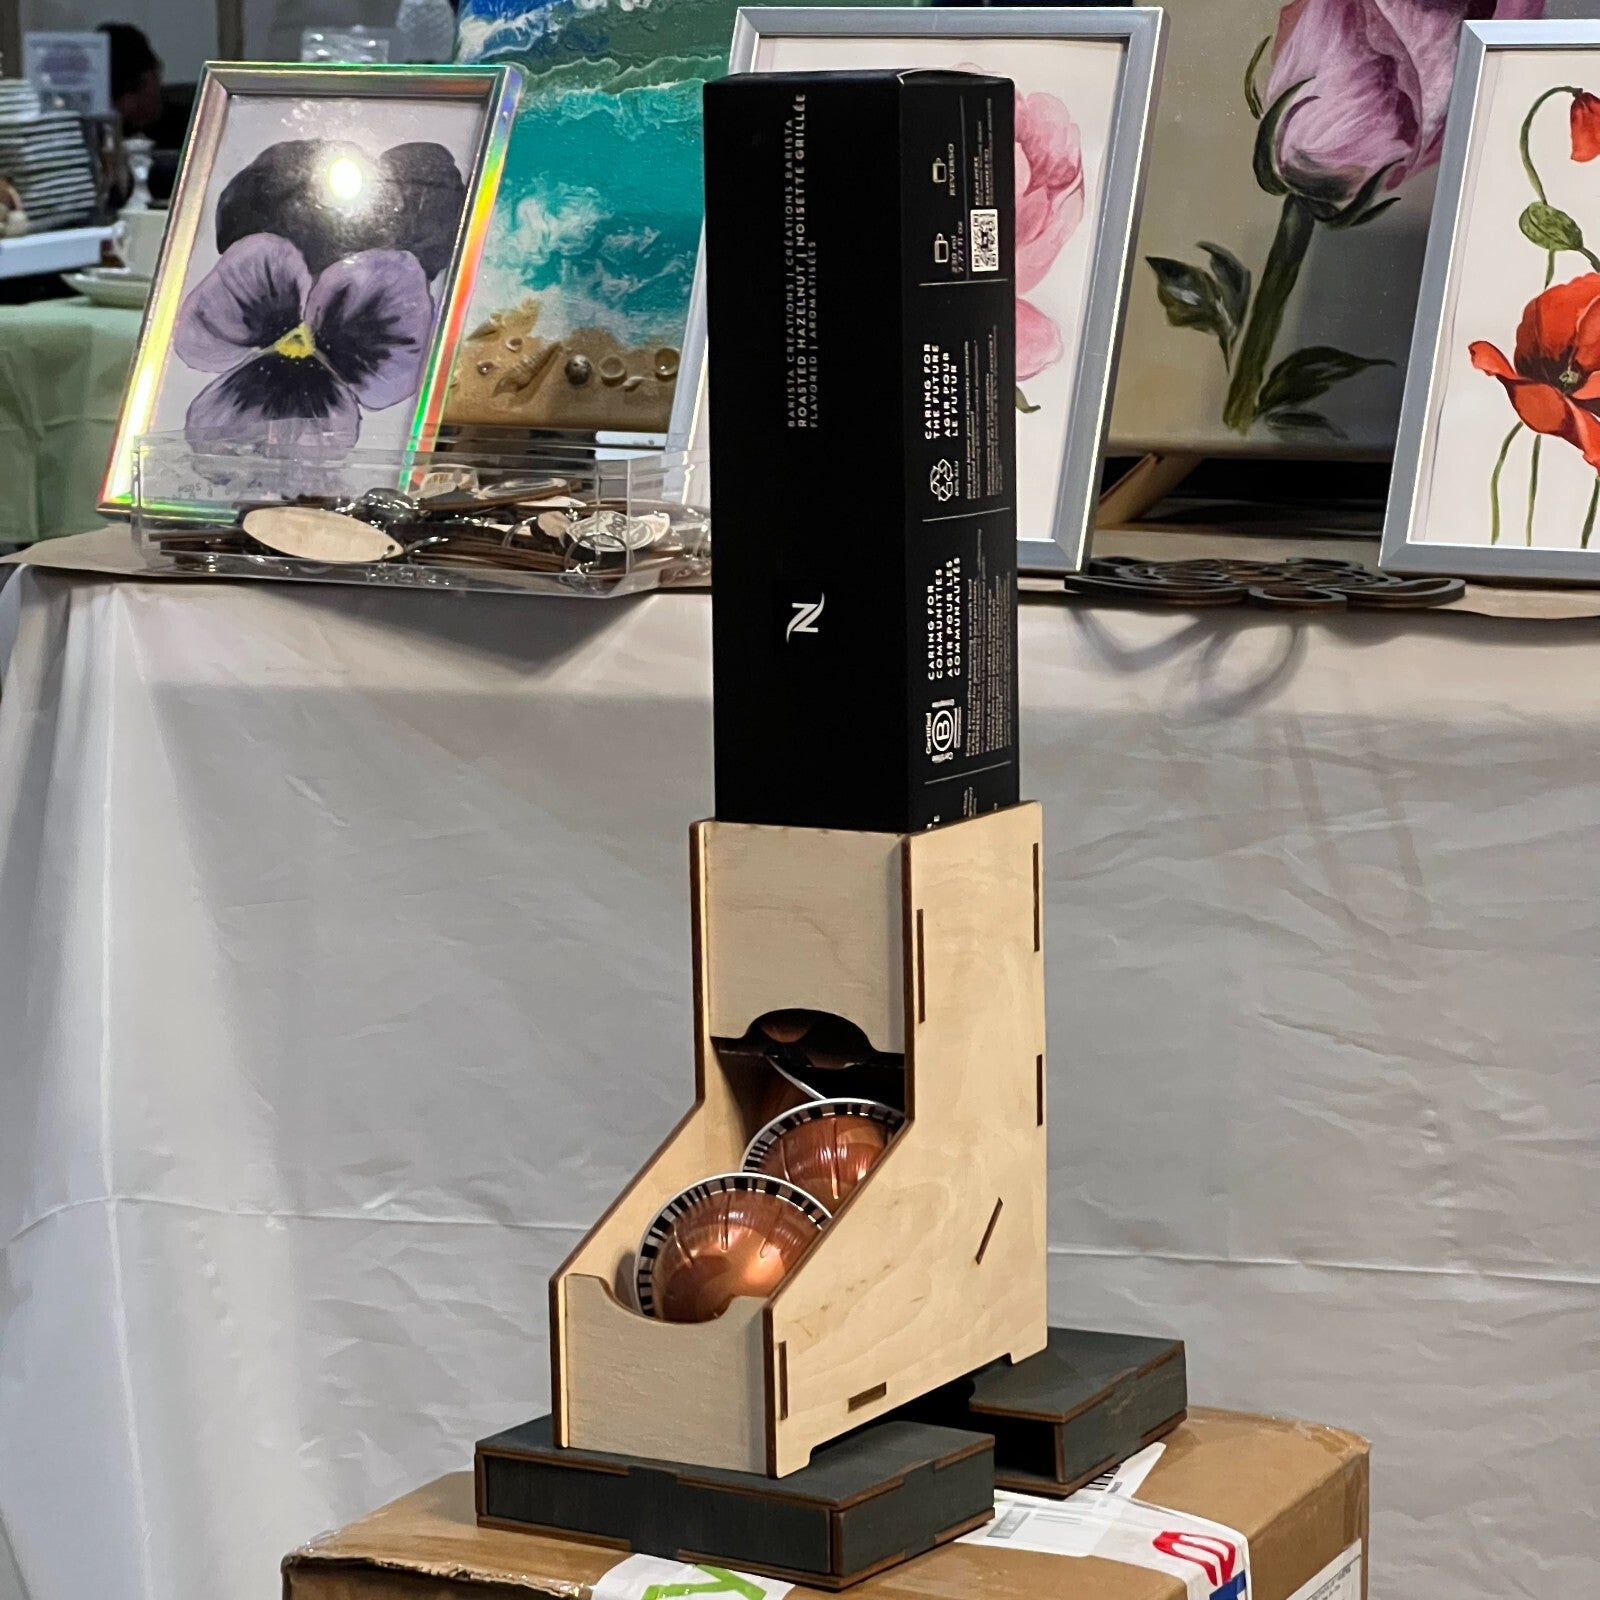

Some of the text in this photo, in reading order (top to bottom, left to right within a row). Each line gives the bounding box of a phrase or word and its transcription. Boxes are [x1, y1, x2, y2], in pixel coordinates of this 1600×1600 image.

[784, 119, 793, 179] BARISTA
[792, 94, 806, 160] GRILLÉE
[795, 166, 805, 246] NOISETTE
[947, 142, 955, 196] REVERSO
[783, 186, 794, 266] CRÉATIONS
[785, 284, 795, 363] CREATIONS
[795, 265, 806, 349] HAZELNUT
[805, 241, 817, 339] AROMATISÉES
[786, 369, 795, 428] BARISTA
[797, 356, 807, 427] ROASTED
[809, 356, 818, 428] FLAVORED
[923, 342, 932, 440] CARING FOR
[931, 344, 940, 438] THE FUTURE
[950, 363, 958, 437] LE FUTUR
[927, 618, 935, 681] CARING
[935, 567, 943, 680] COMMUNITIES
[945, 591, 953, 635] POUR
[952, 556, 961, 677] COMMUNAUTÉS
